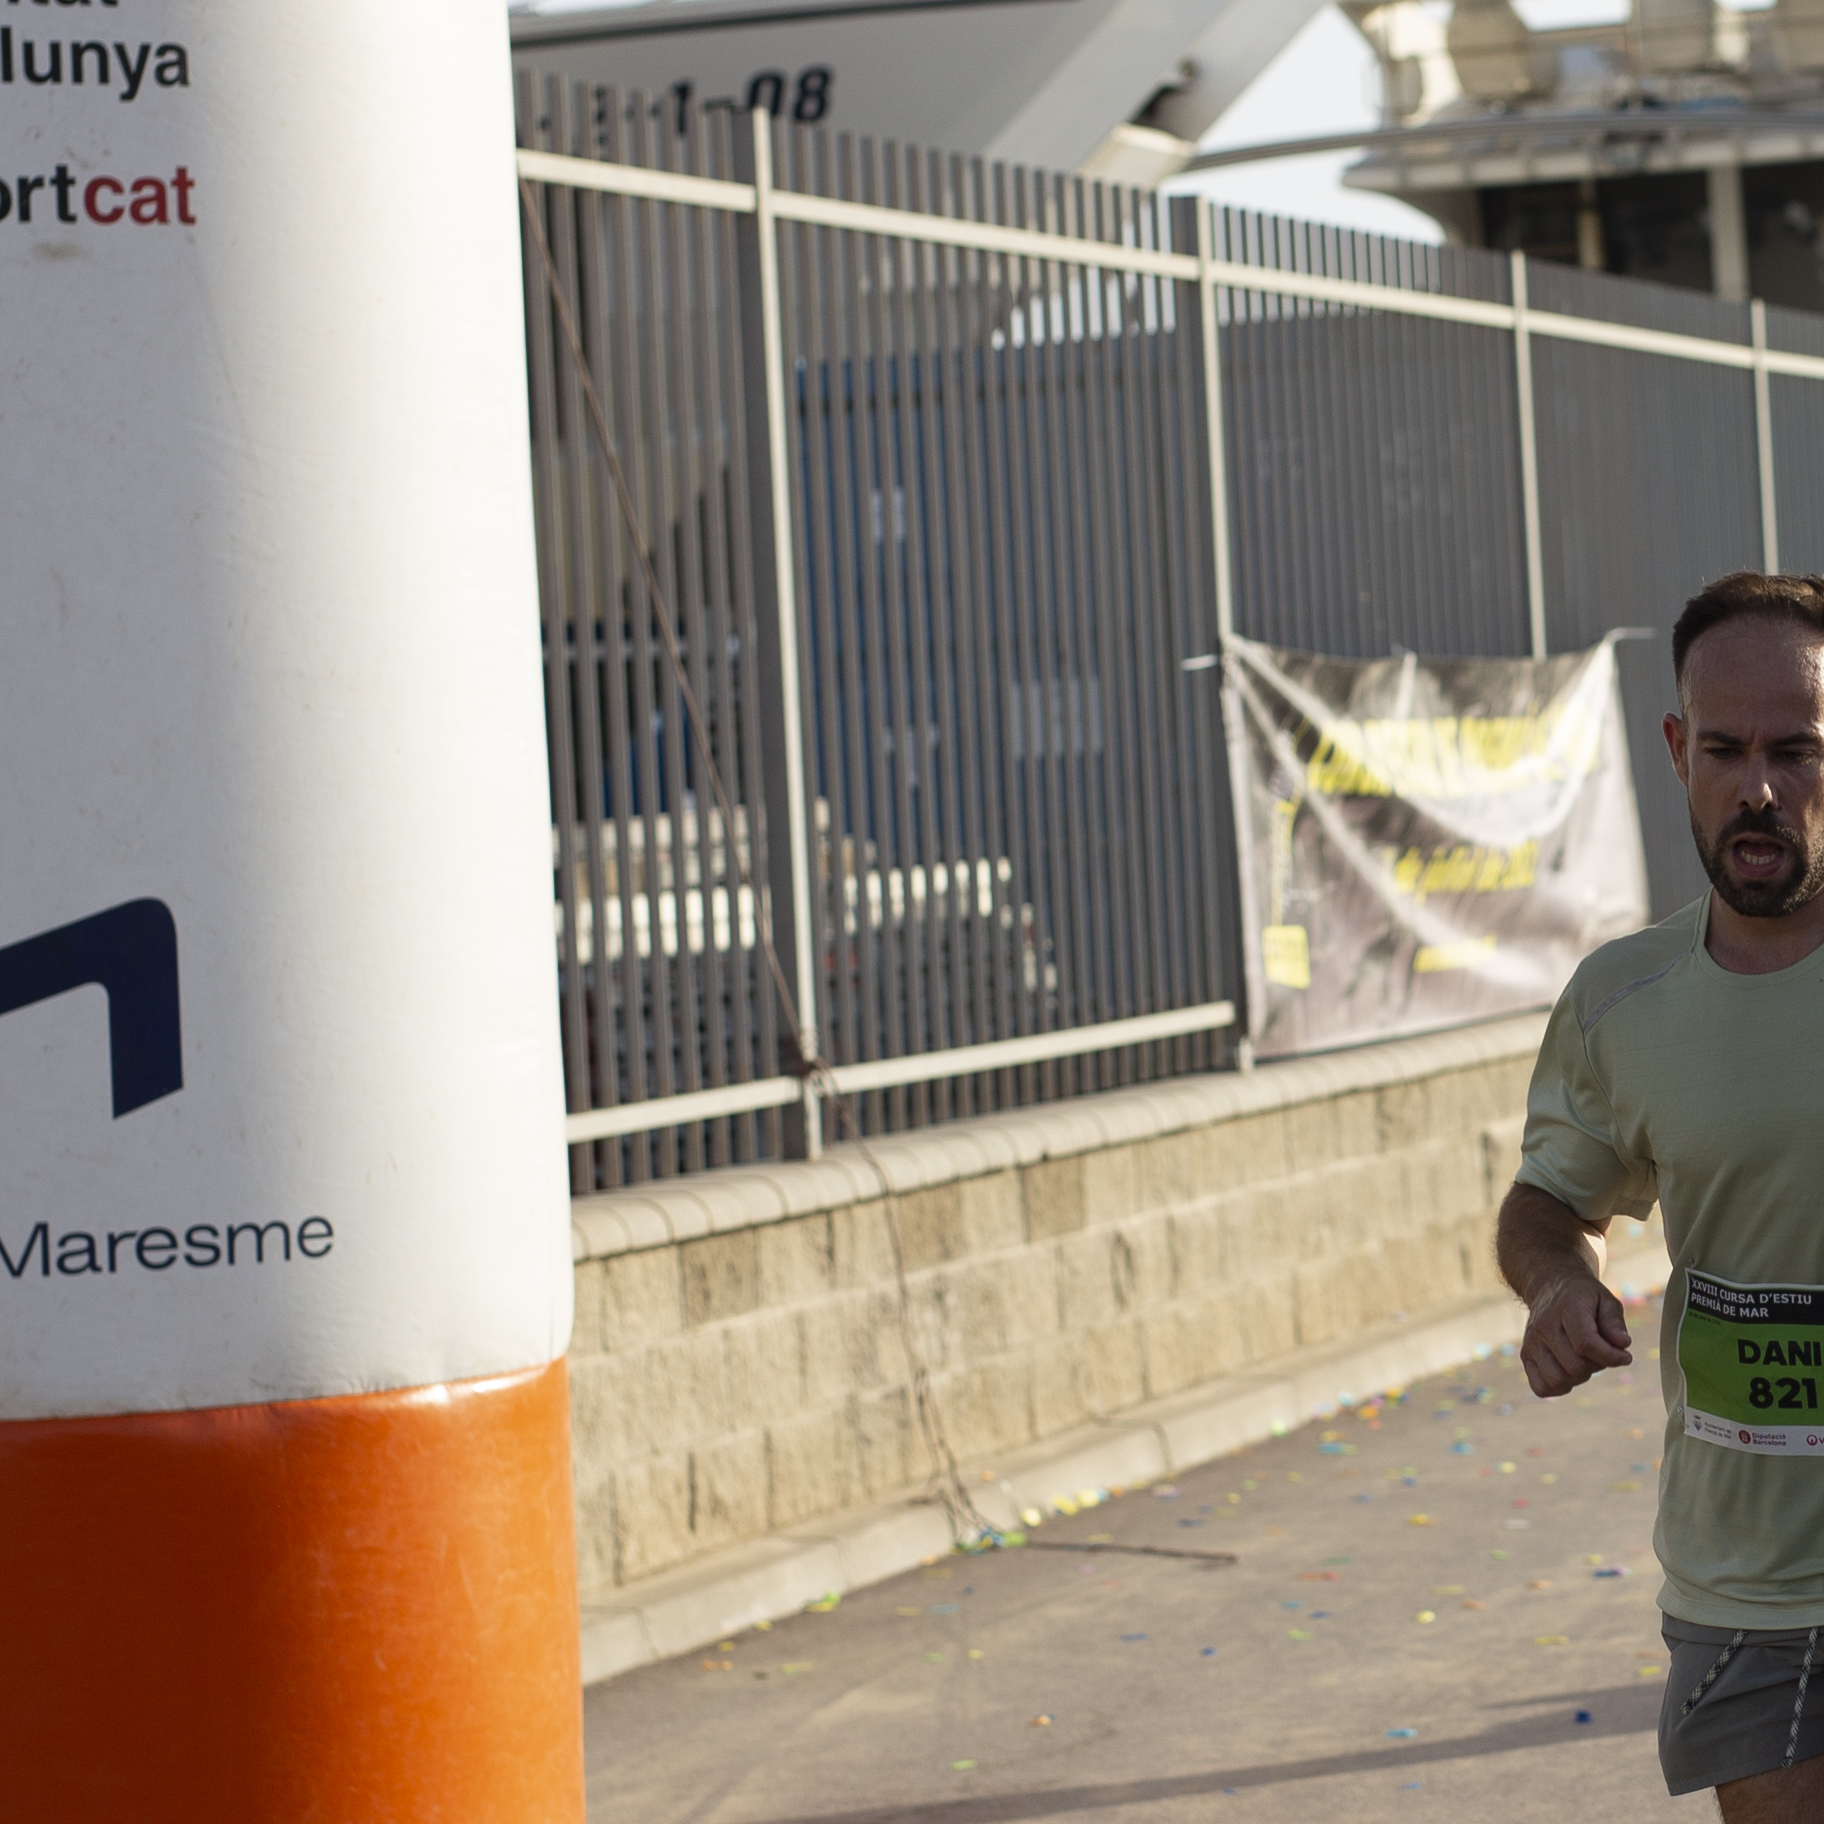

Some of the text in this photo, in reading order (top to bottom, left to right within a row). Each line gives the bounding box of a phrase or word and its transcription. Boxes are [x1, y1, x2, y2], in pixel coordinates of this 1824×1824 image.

[0, 166, 196, 225] rtcat
[0, 1215, 334, 1280] Maresme
[1691, 1277, 1812, 1305] XXVIII CURSA D'ESTIU
[1691, 1292, 1769, 1318] PREMIÀ DE MAR
[1737, 1339, 1822, 1366] DANI
[1748, 1376, 1818, 1409] 821
